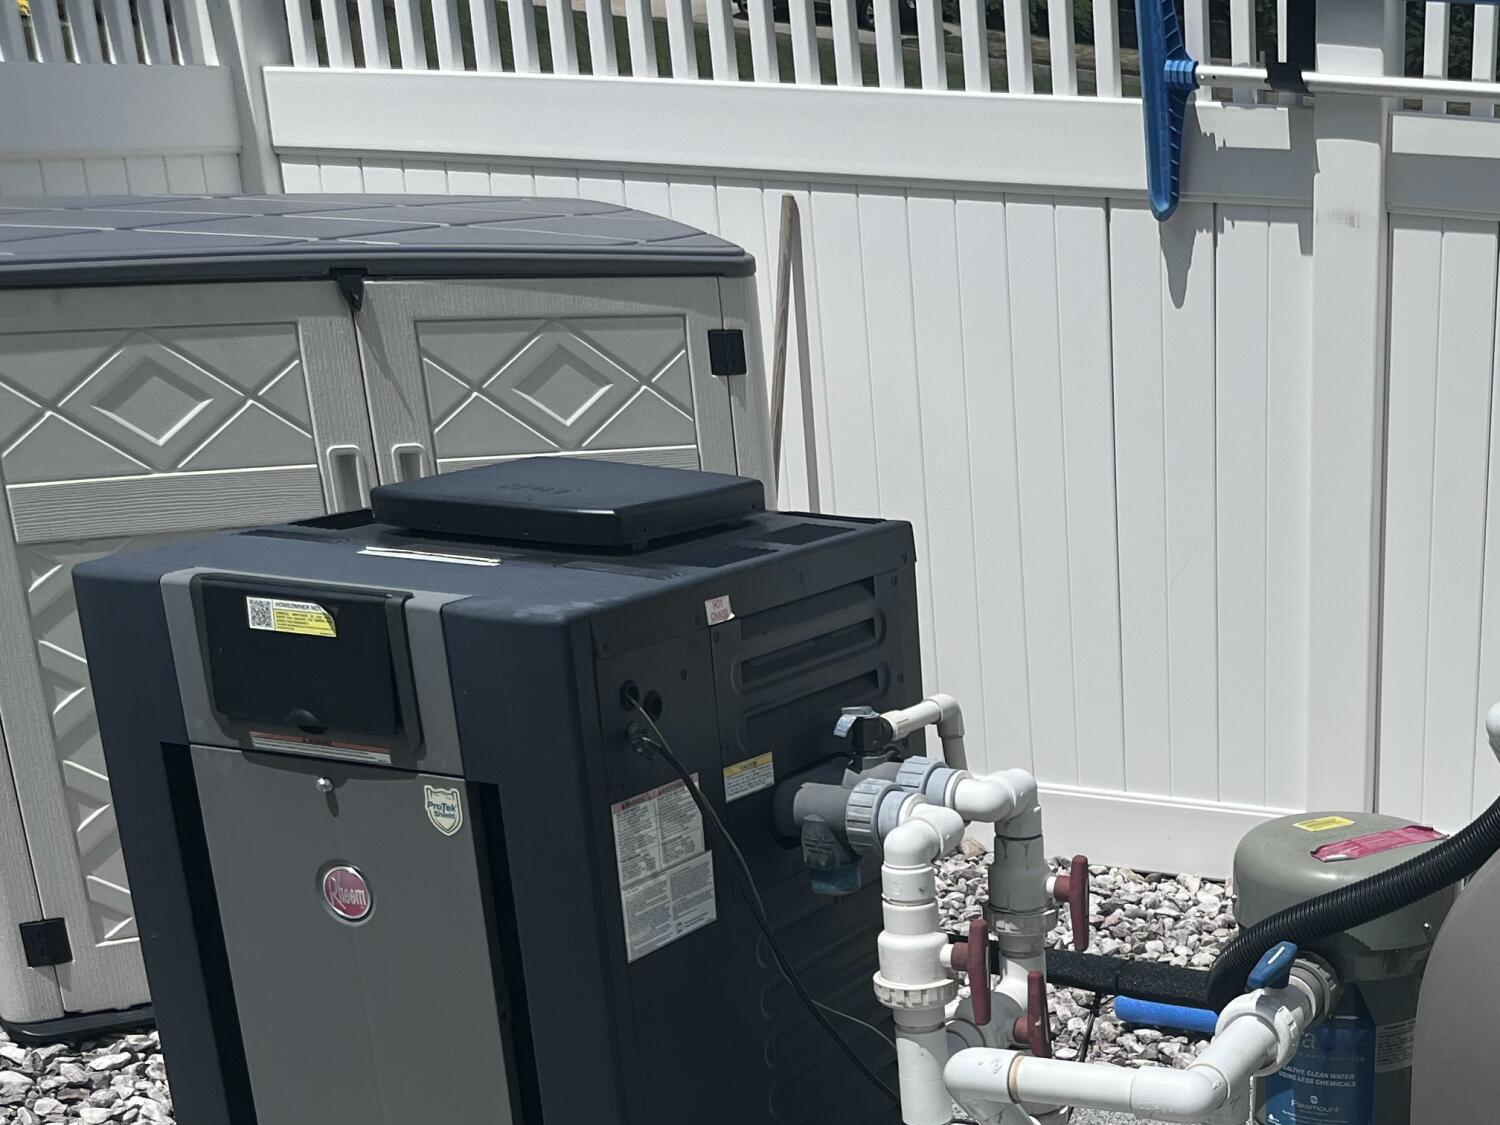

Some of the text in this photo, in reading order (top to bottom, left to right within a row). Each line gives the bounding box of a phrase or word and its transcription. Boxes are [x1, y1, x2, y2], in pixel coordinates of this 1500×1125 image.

[328, 870, 367, 909] Rheem
[1278, 1071, 1357, 1088] USING LESS CHEMICALS
[1306, 1070, 1329, 1078] CLEAN
[1291, 1099, 1340, 1113] Paramount
